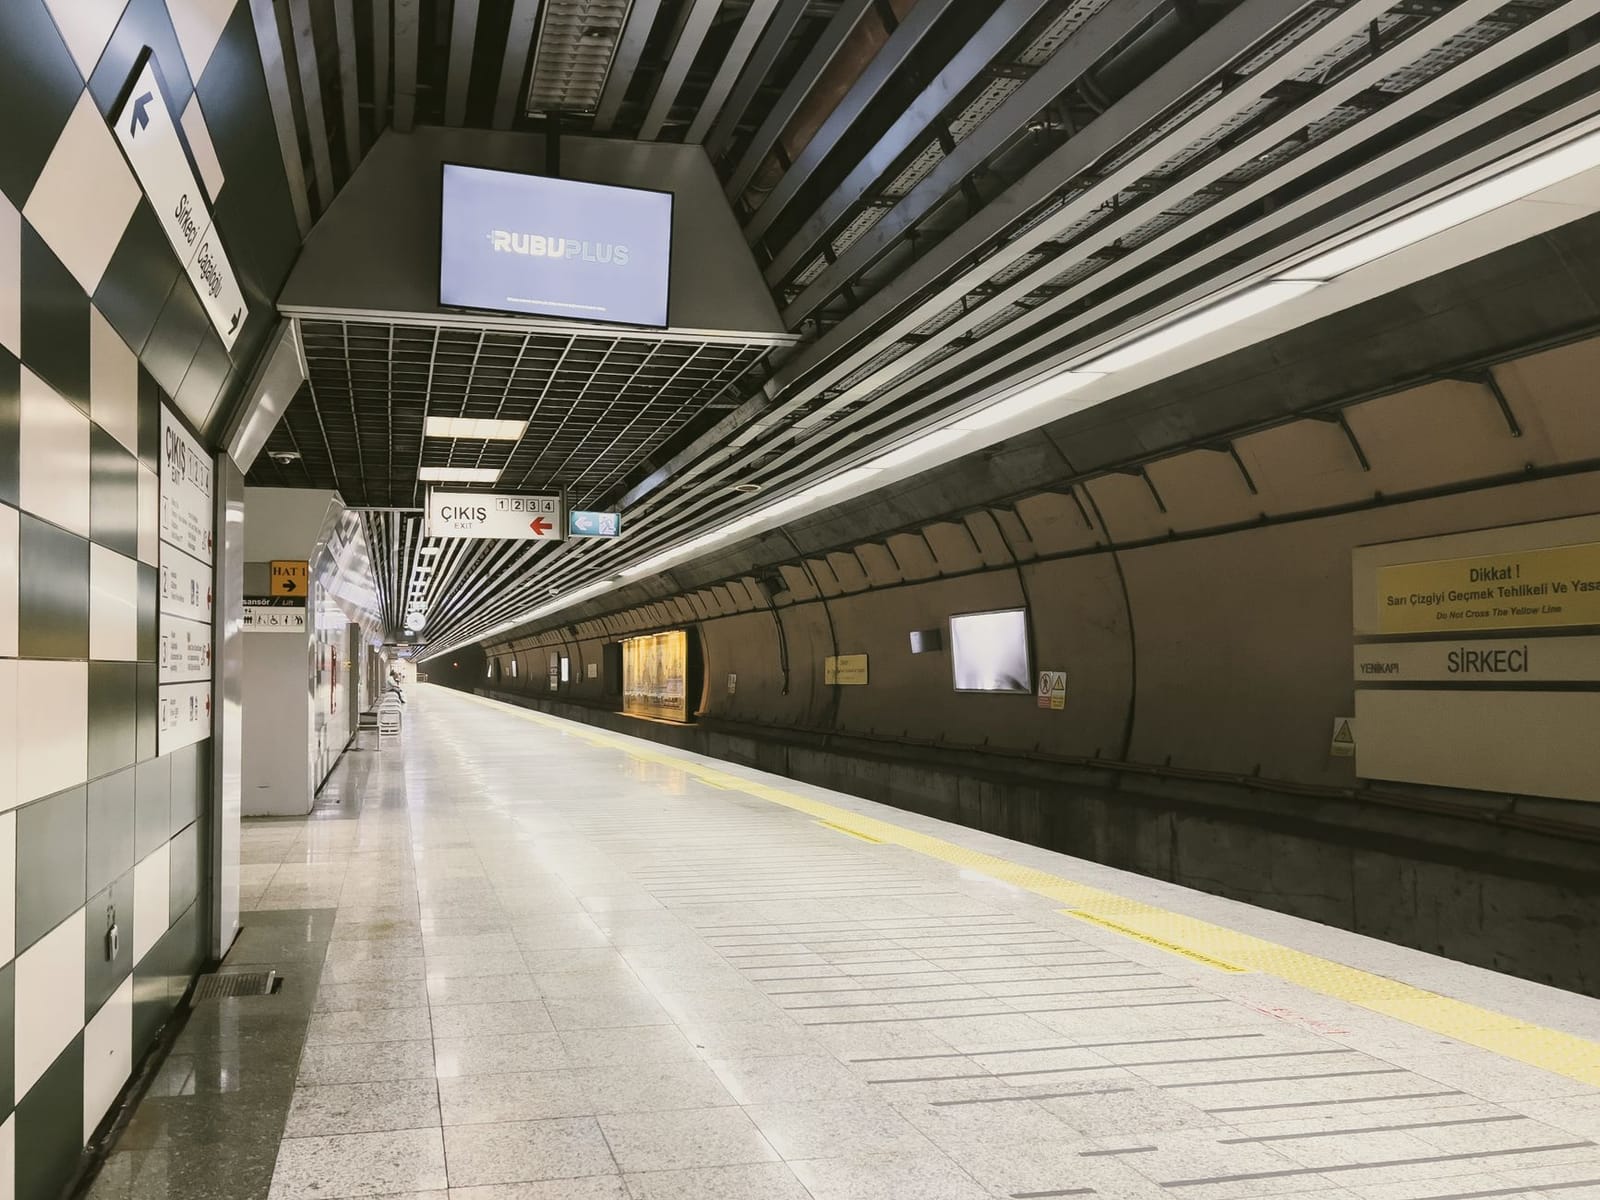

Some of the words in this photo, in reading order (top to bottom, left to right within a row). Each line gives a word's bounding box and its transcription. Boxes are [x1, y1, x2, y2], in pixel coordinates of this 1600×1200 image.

[174, 193, 201, 248] Sirkeci
[165, 425, 186, 481] ÇIKIŞ
[441, 505, 487, 523] ÇIKIŞ
[514, 500, 521, 510] 2
[529, 501, 536, 510] 3
[544, 501, 551, 511] 4
[273, 567, 298, 576] HAT
[1470, 565, 1512, 582] Dikkat
[242, 597, 270, 606] sansör
[1409, 591, 1445, 607] Çizgiyi
[1448, 587, 1494, 603] Geçmek
[1497, 582, 1548, 599] Tehlikeli
[1551, 581, 1568, 594] Ve
[1449, 610, 1464, 620] Not
[1465, 608, 1490, 618] Cross
[1492, 607, 1508, 617] The
[1511, 606, 1539, 616] Yellow
[1542, 604, 1562, 614] Line
[1448, 644, 1528, 673] SİRKECİ
